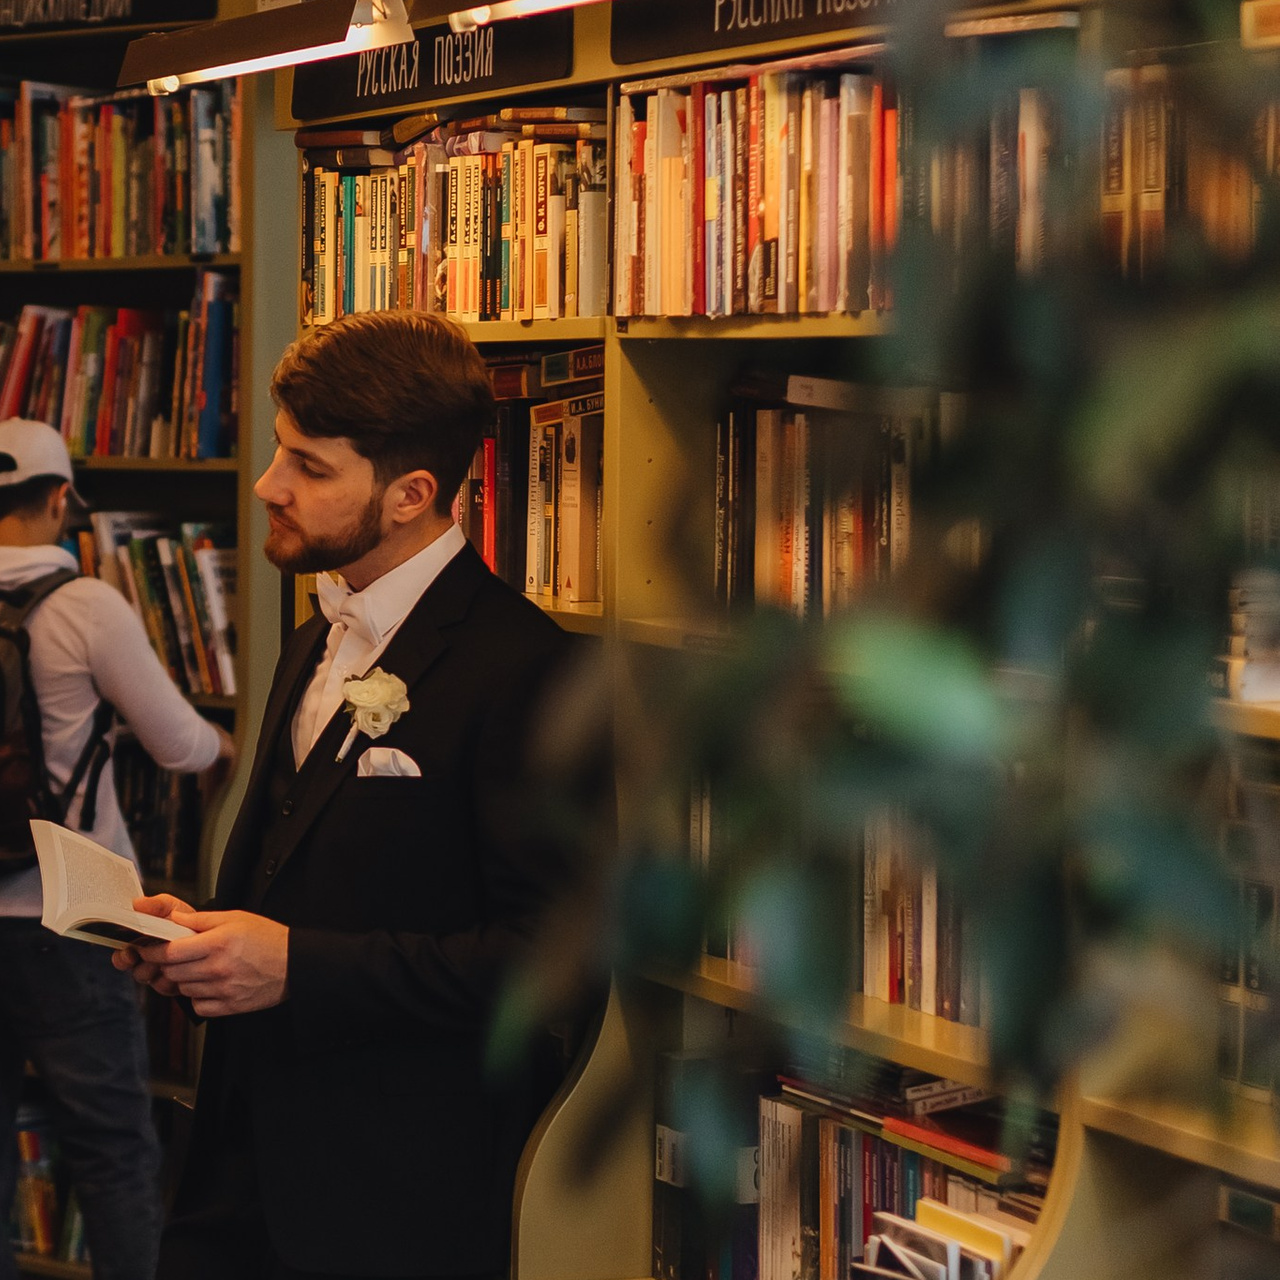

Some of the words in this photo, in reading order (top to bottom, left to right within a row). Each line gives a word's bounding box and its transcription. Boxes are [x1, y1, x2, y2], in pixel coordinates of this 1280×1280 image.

[356, 40, 420, 98] РУССКАЯ
[432, 26, 495, 87] ПОЭЗИЯ
[537, 159, 546, 203] ТЮТЧЕВ
[588, 351, 603, 369] БЛО
[586, 397, 604, 411] БУНИ
[529, 425, 539, 473] БРЮСО
[528, 474, 538, 537] ВАЛЕРИЙ
